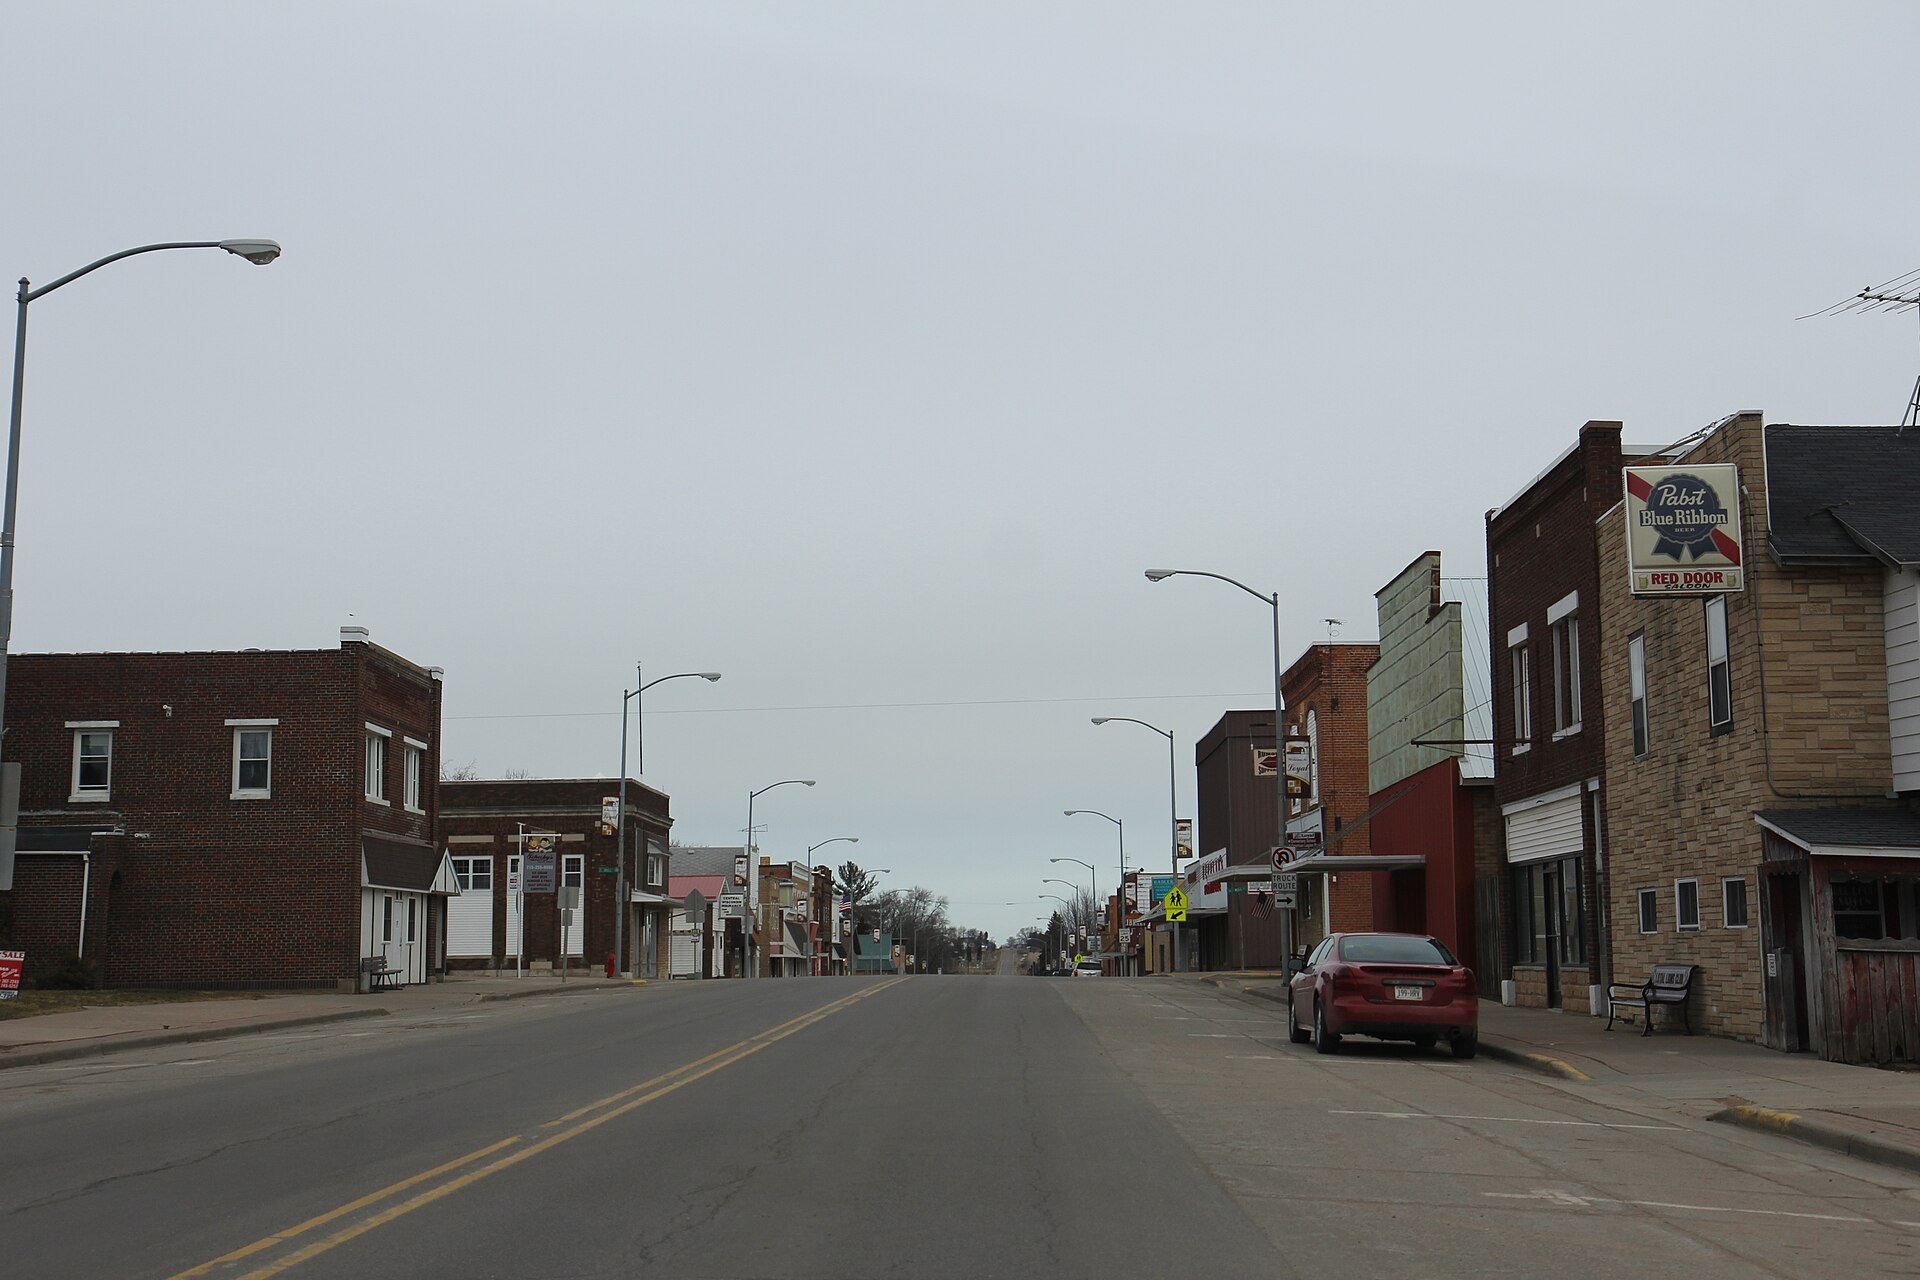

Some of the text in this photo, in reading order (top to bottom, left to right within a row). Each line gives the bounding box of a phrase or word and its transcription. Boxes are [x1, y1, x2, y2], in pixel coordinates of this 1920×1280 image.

[1658, 484, 1706, 506] Pabst
[1641, 508, 1727, 526] Blue Ribbon
[1651, 572, 1724, 585] RED DOOR
[1287, 764, 1309, 773] Loyal
